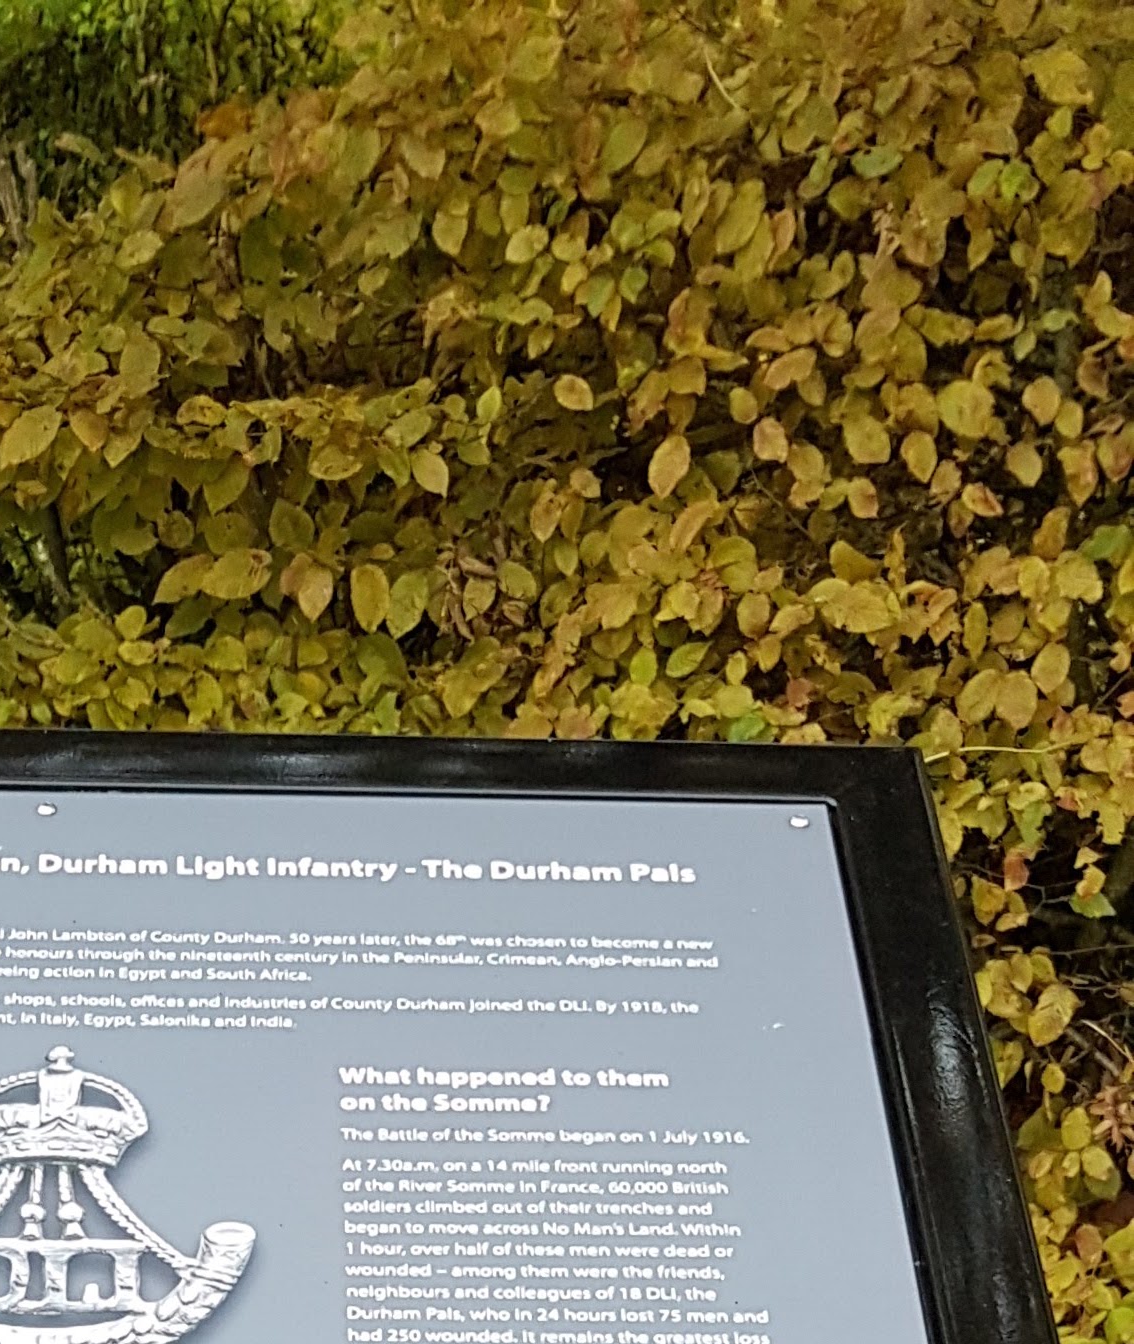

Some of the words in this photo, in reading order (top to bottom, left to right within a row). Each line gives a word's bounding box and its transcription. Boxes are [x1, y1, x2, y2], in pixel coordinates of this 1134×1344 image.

[38, 853, 168, 874] Durham
[176, 855, 259, 880] Light
[267, 857, 397, 881] Infantry
[421, 859, 483, 879] The
[490, 860, 622, 881] Durham
[630, 863, 696, 883] Pals
[5, 946, 74, 959] honours
[77, 948, 145, 963] through
[148, 949, 177, 961] the
[180, 950, 271, 962] nineteenth
[274, 952, 339, 965] century
[342, 951, 359, 963] in
[362, 951, 390, 964] the
[566, 954, 682, 968] Anglo-Persian
[686, 956, 719, 968] and
[339, 1067, 411, 1085] What
[416, 1067, 556, 1089] happened
[561, 1069, 591, 1086] to
[596, 1069, 669, 1087] them
[340, 1097, 376, 1111] on
[381, 1093, 428, 1111] the
[433, 1094, 550, 1112] Somme?
[344, 1199, 412, 1213] soldiers
[415, 1200, 488, 1214] climbed
[492, 1202, 523, 1214] out
[526, 1200, 546, 1214] of
[549, 1201, 592, 1214] their
[595, 1202, 674, 1215] trenches
[678, 1202, 713, 1215] and
[344, 1220, 401, 1237] began
[404, 1222, 425, 1234] to
[428, 1223, 479, 1235] move
[483, 1223, 539, 1235] across
[542, 1222, 570, 1236] No
[628, 1222, 679, 1236] Land.
[680, 1223, 742, 1236] Within
[346, 1241, 353, 1255] 1
[360, 1241, 407, 1257] hour,
[410, 1245, 450, 1256] over
[454, 1241, 490, 1256] half
[492, 1241, 512, 1256] of
[515, 1242, 565, 1257] these
[569, 1246, 611, 1257] men
[614, 1246, 660, 1258] were
[663, 1244, 710, 1258] dead
[714, 1247, 734, 1258] or
[347, 1327, 383, 1342] had
[387, 1328, 422, 1342] 250
[425, 1329, 518, 1343] wounded.
[522, 1329, 536, 1344] It
[540, 1330, 614, 1344] remains
[617, 1330, 649, 1344] the
